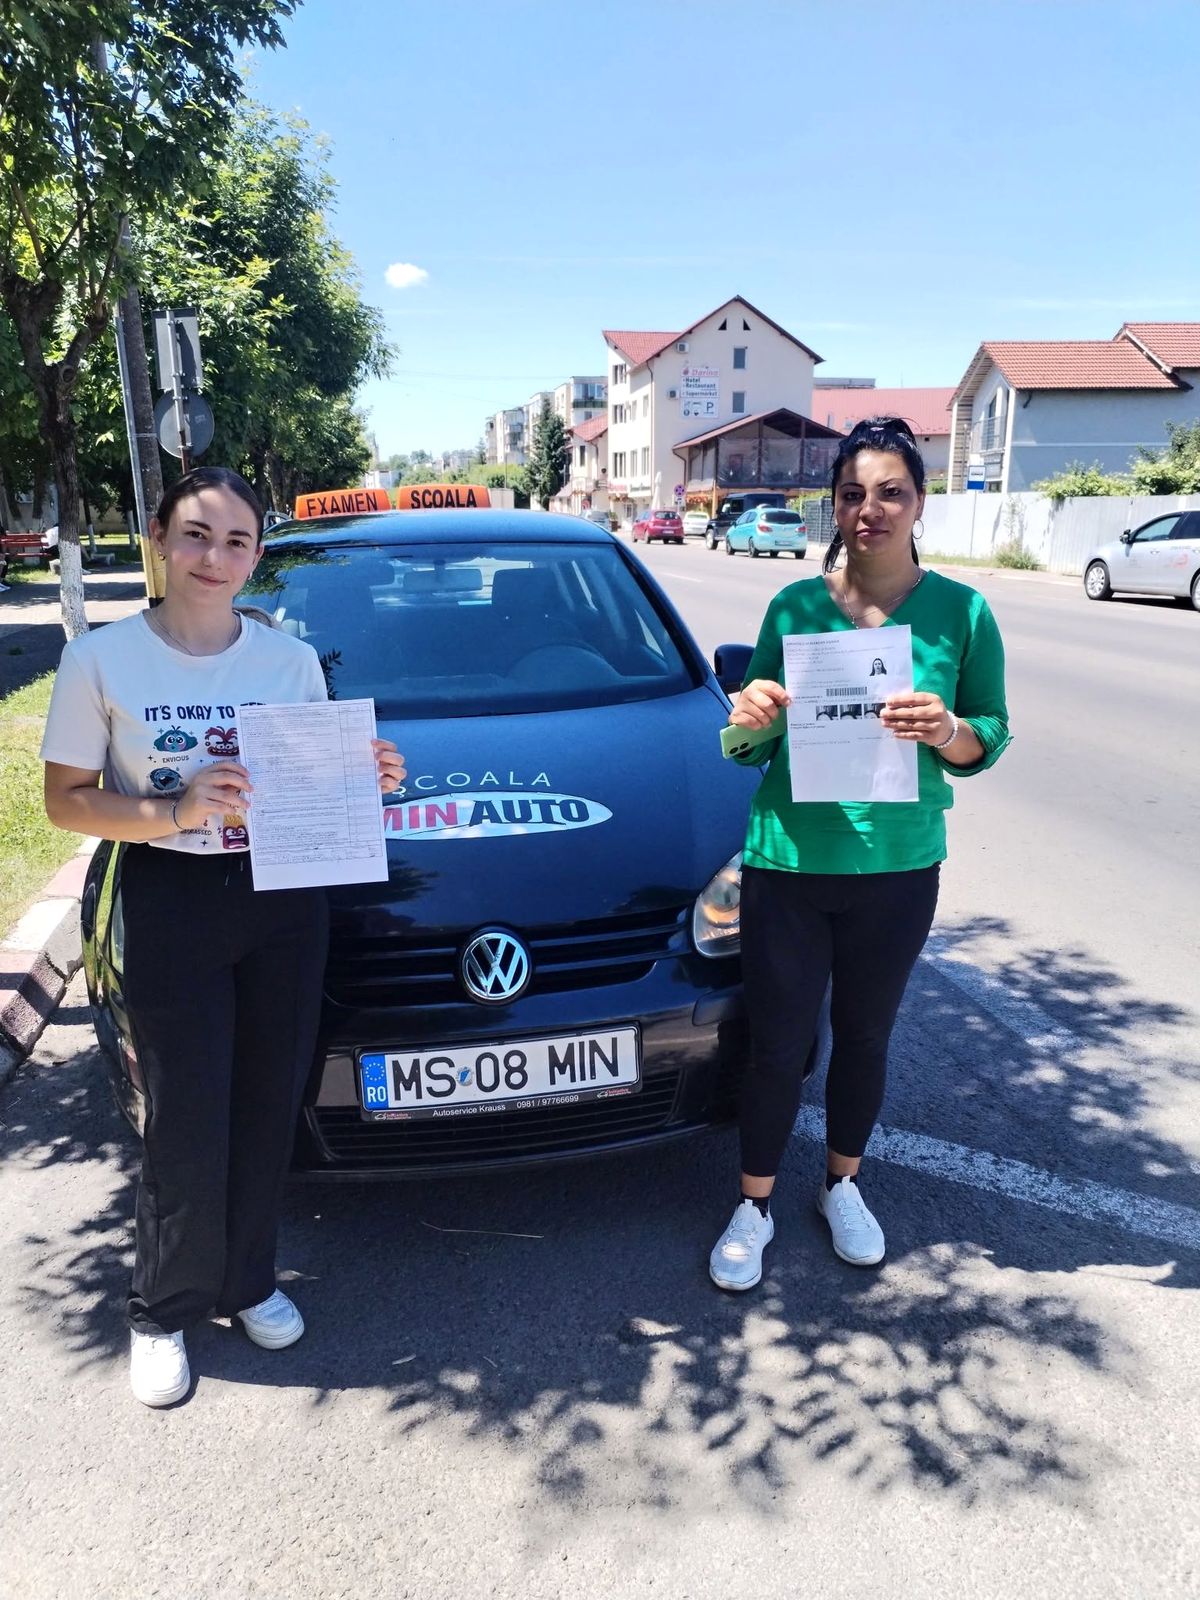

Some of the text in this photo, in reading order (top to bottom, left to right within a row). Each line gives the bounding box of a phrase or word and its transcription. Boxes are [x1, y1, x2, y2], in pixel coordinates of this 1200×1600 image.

[306, 492, 379, 517] EXAMEN
[144, 705, 236, 721] IT'S OKAY TO
[468, 799, 590, 827] AUTO
[391, 1037, 619, 1101] MS 08 MIN
[367, 1086, 387, 1103] RO
[432, 1106, 478, 1117] Autoservice
[479, 1104, 506, 1113] Krauss
[516, 1100, 535, 1109] 0981
